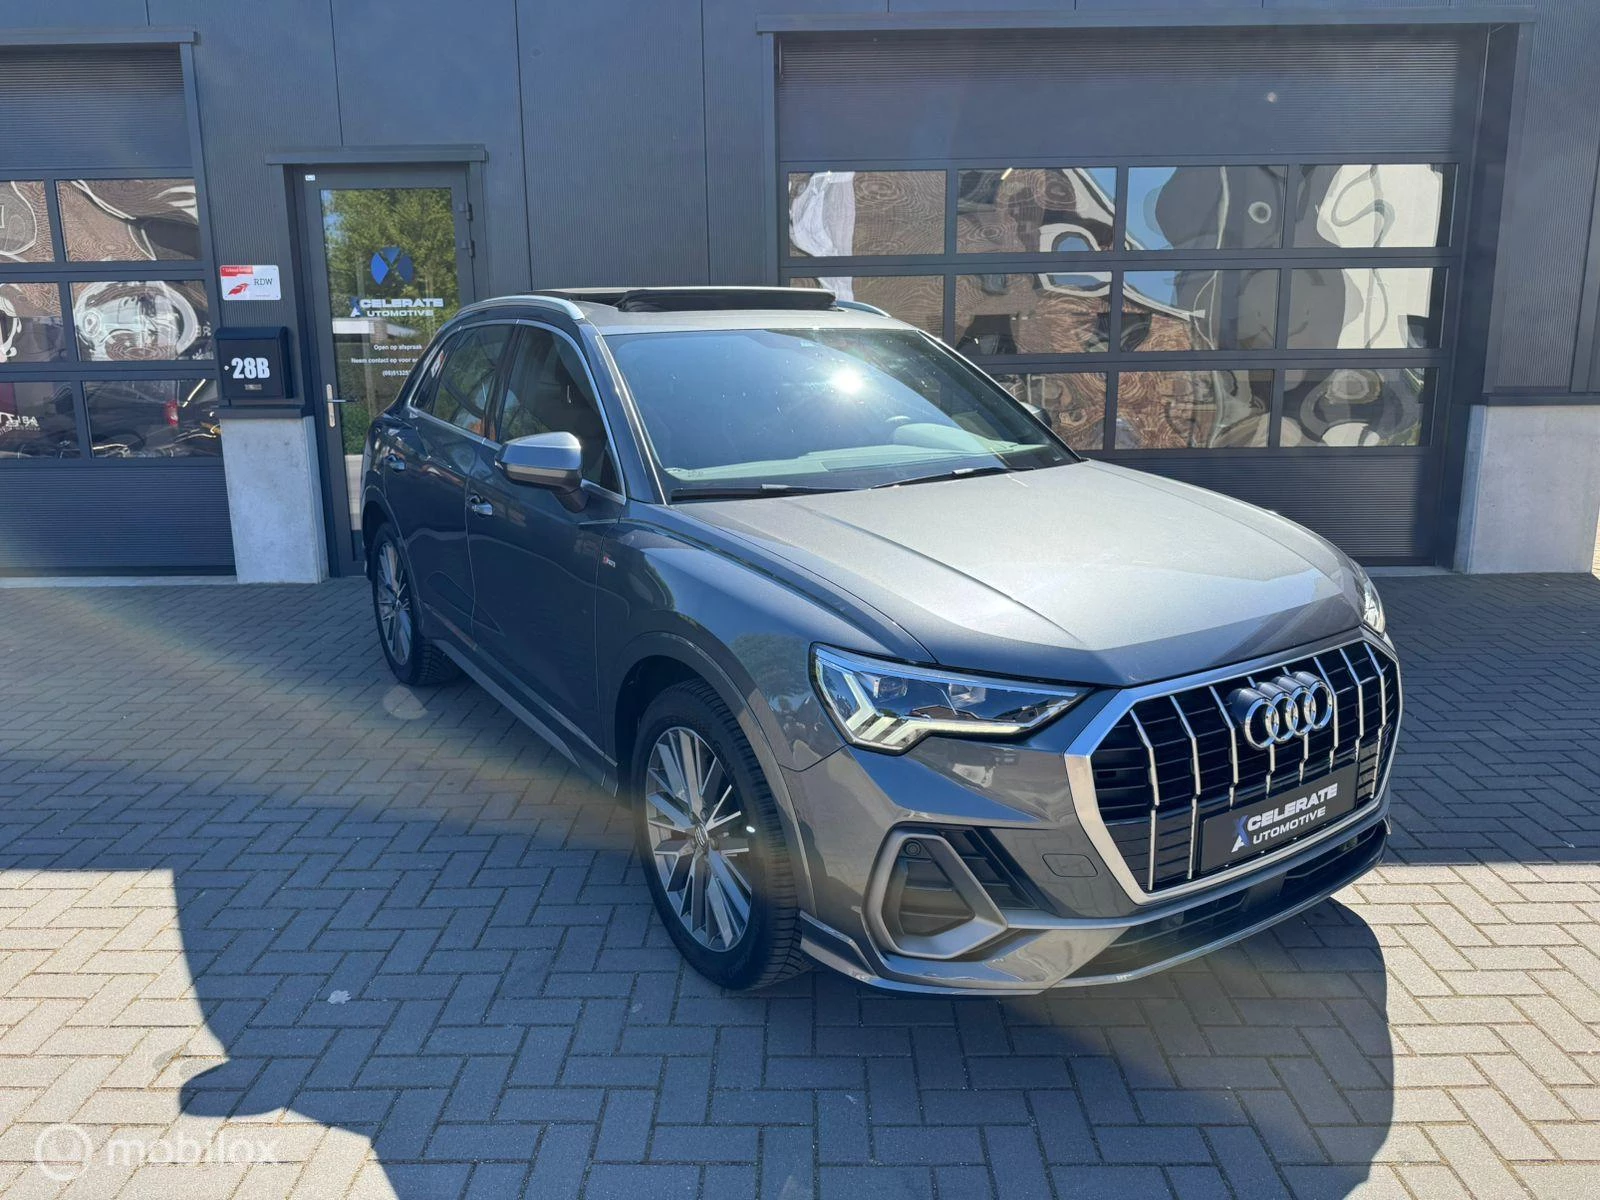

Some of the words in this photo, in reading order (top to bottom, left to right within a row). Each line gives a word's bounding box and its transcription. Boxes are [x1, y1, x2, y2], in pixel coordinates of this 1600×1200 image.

[253, 278, 273, 286] RDW
[231, 357, 270, 379] 28B
[1231, 806, 1326, 853] AUTOMOTIVE
